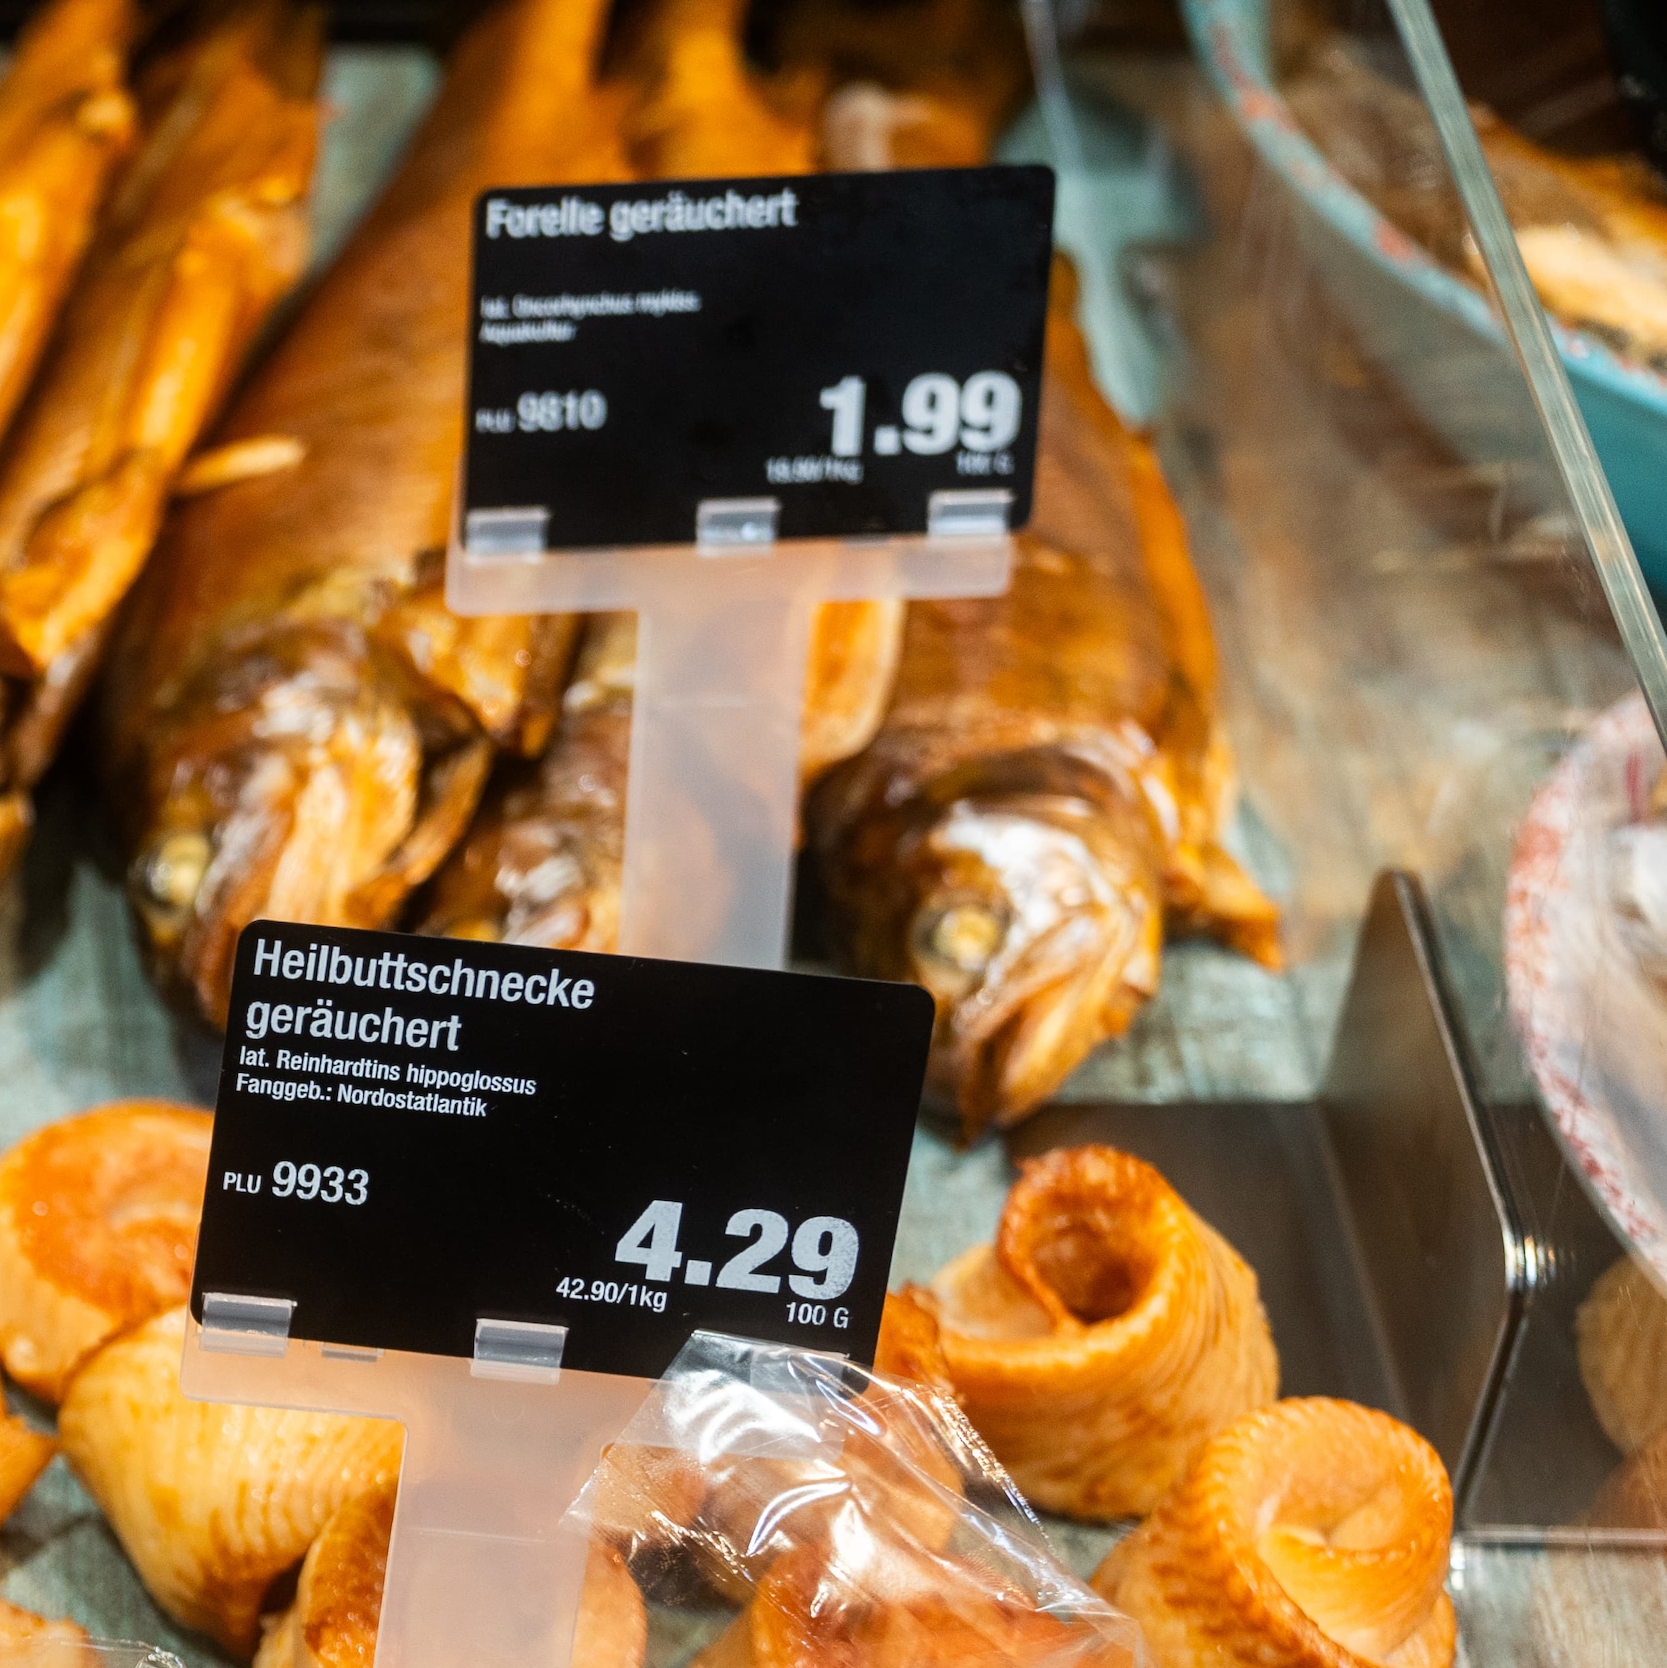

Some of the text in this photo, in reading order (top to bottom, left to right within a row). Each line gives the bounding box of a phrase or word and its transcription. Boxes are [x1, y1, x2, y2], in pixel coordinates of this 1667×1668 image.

[487, 188, 798, 242] Forelle geräuchert
[517, 389, 608, 433] 9810
[820, 371, 1021, 457] 1.99
[253, 938, 595, 1009] Heilbuttschnecke
[245, 1000, 462, 1051] geräuchert
[237, 1071, 488, 1117] Fanggeb.: Nordostatlantik
[240, 1047, 537, 1095] lat. Reinhardtins hippoglossus
[223, 1161, 369, 1206] PLU 9933
[615, 1200, 859, 1300] 4.29
[556, 1277, 668, 1313] 42.90/1kg
[787, 1302, 849, 1329] 100 G
